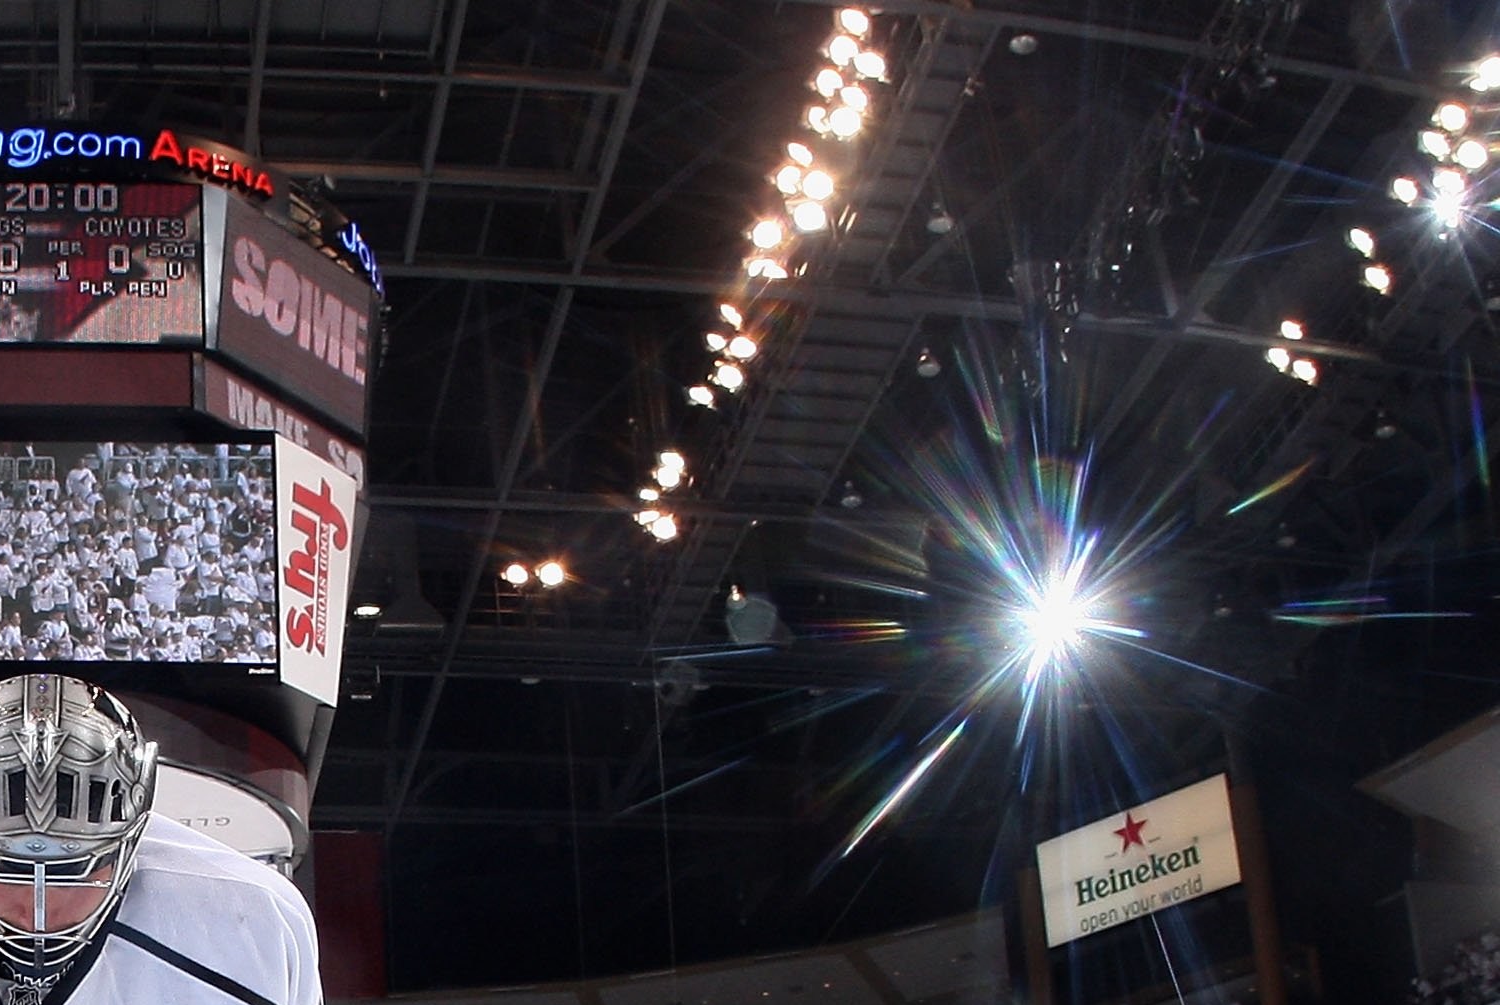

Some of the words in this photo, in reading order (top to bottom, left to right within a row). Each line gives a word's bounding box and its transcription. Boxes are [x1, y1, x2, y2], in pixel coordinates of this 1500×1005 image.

[150, 128, 275, 196] ARENA
[5, 183, 118, 212] 20:00
[85, 217, 185, 237] COYOTES
[49, 242, 84, 256] PER
[108, 244, 130, 273] 0
[147, 242, 195, 258] SOG
[55, 261, 70, 280] 1
[80, 280, 116, 295] PLR
[127, 281, 166, 296] PEN
[232, 237, 368, 386] SOME
[284, 477, 348, 655] fry's
[317, 522, 330, 572] FOOD
[314, 575, 328, 647] STORES
[1075, 845, 1202, 906] Heineken
[1080, 907, 1118, 933] open
[1122, 894, 1157, 919] your
[1161, 873, 1204, 904] world
